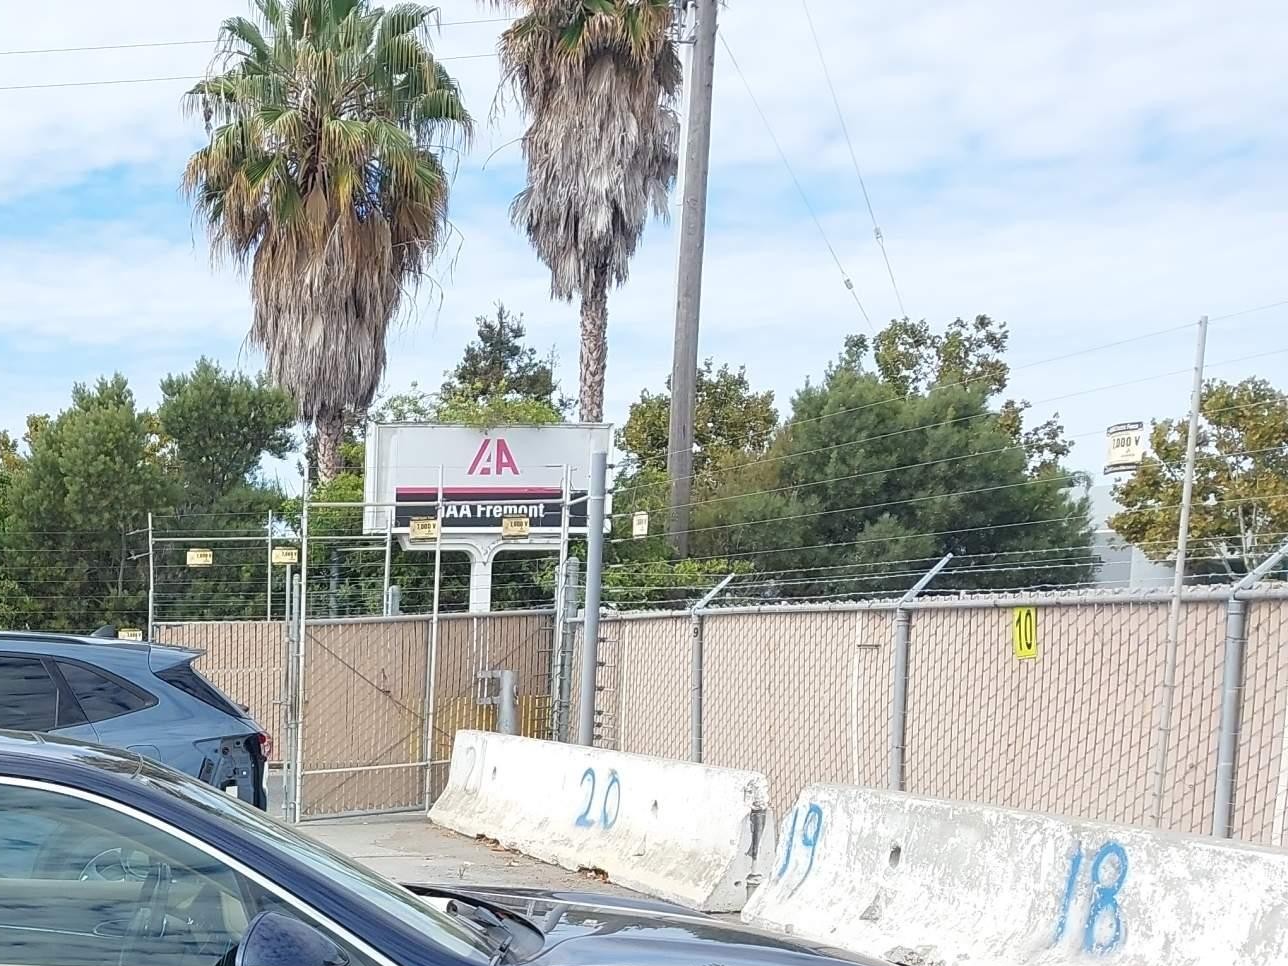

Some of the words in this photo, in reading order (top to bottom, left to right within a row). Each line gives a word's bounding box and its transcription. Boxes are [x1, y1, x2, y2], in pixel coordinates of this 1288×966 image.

[476, 503, 545, 518] Fremont
[693, 627, 699, 638] 9
[1015, 609, 1033, 651] 10
[575, 767, 621, 831] 20
[776, 803, 823, 900] 19
[1052, 840, 1128, 955] 18
